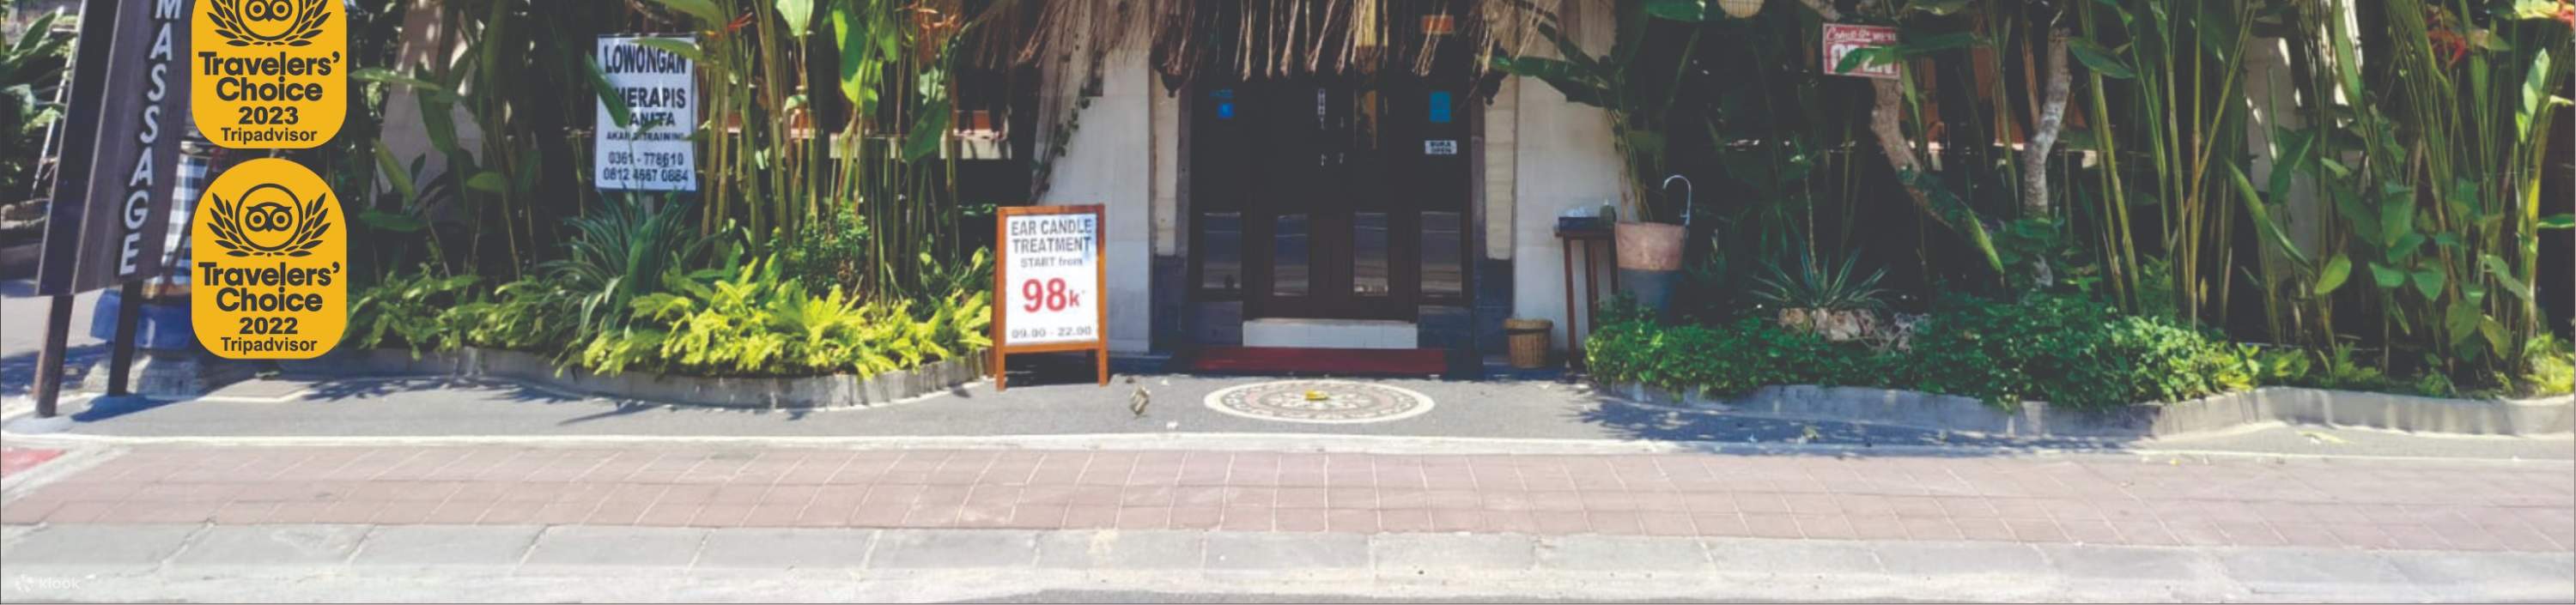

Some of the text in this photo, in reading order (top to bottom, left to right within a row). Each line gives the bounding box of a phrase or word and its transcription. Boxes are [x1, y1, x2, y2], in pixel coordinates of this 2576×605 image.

[604, 44, 686, 75] LOWONGAN
[614, 87, 686, 109] HERAPIS
[628, 112, 677, 127] ANITA
[1011, 218, 1093, 236] EAR CANDLE
[1012, 236, 1091, 253] TREATMENT
[1020, 256, 1084, 269] START from
